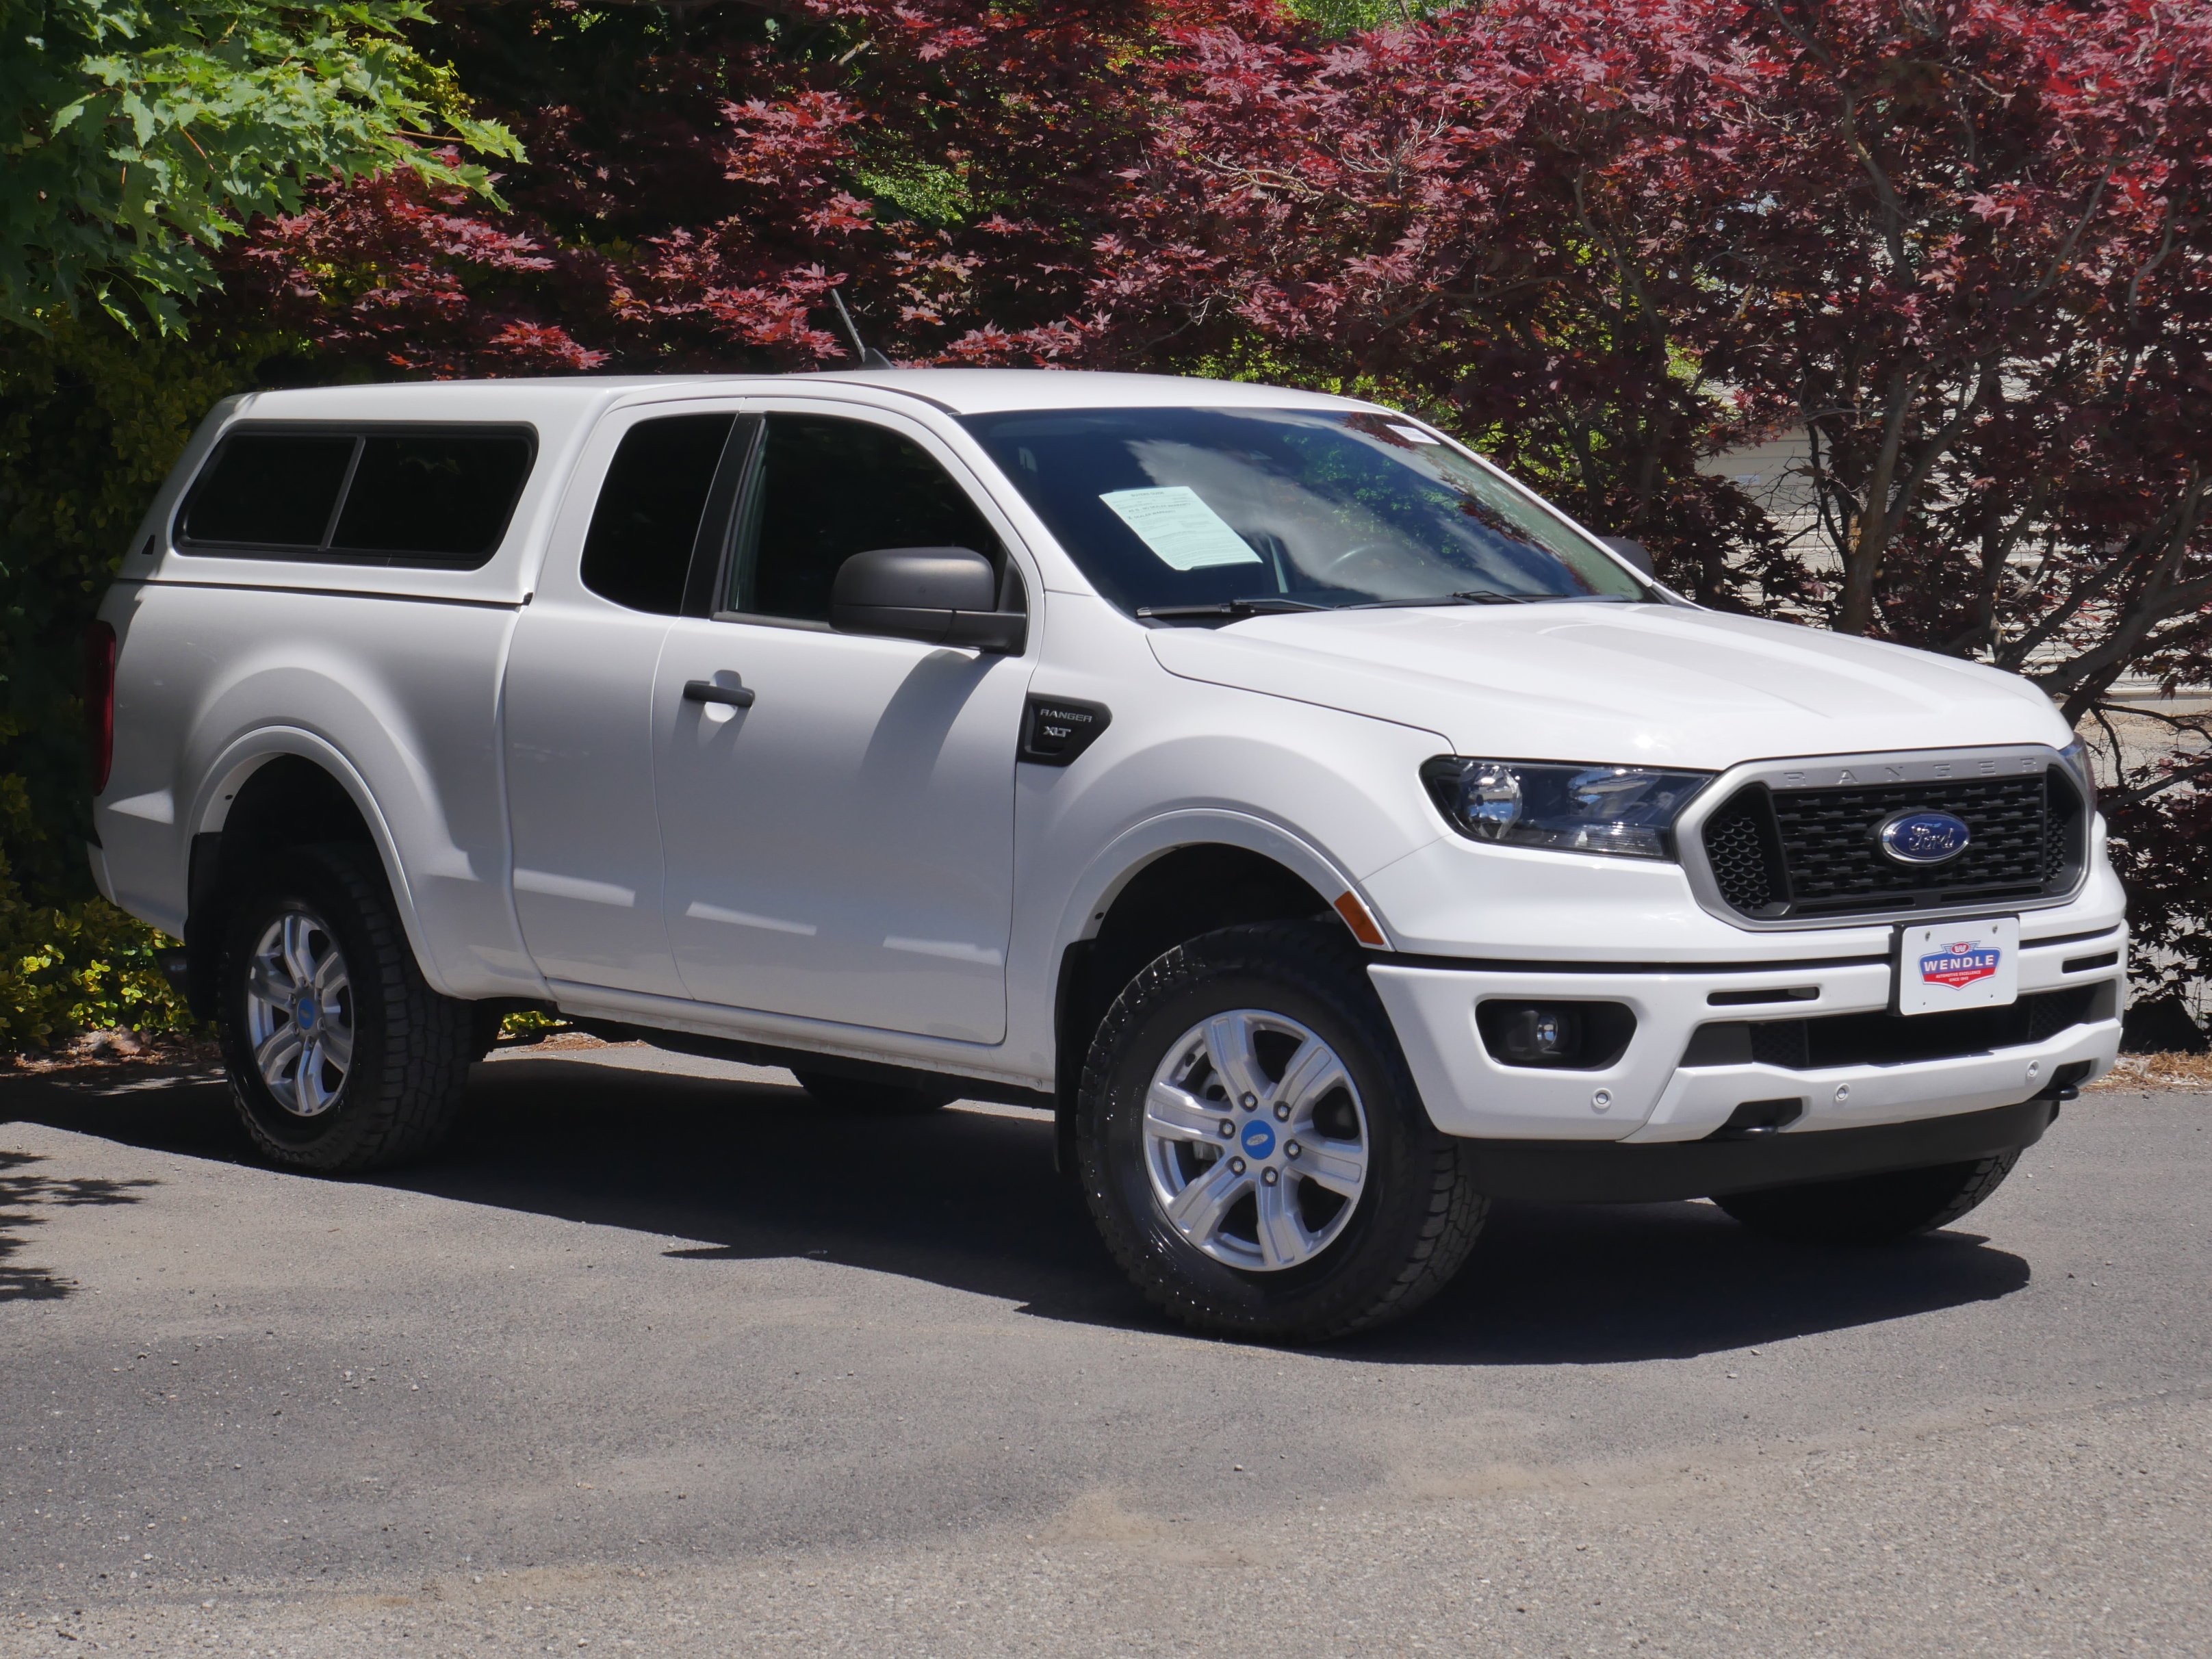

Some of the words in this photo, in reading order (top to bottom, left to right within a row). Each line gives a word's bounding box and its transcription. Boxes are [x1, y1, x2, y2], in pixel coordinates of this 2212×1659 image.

[1040, 708, 1092, 723] RANGER
[1043, 725, 1072, 738] XLT
[1784, 758, 2038, 787] RANGER
[1908, 822, 1955, 851] Ford
[1924, 955, 1994, 971] WENDLE
